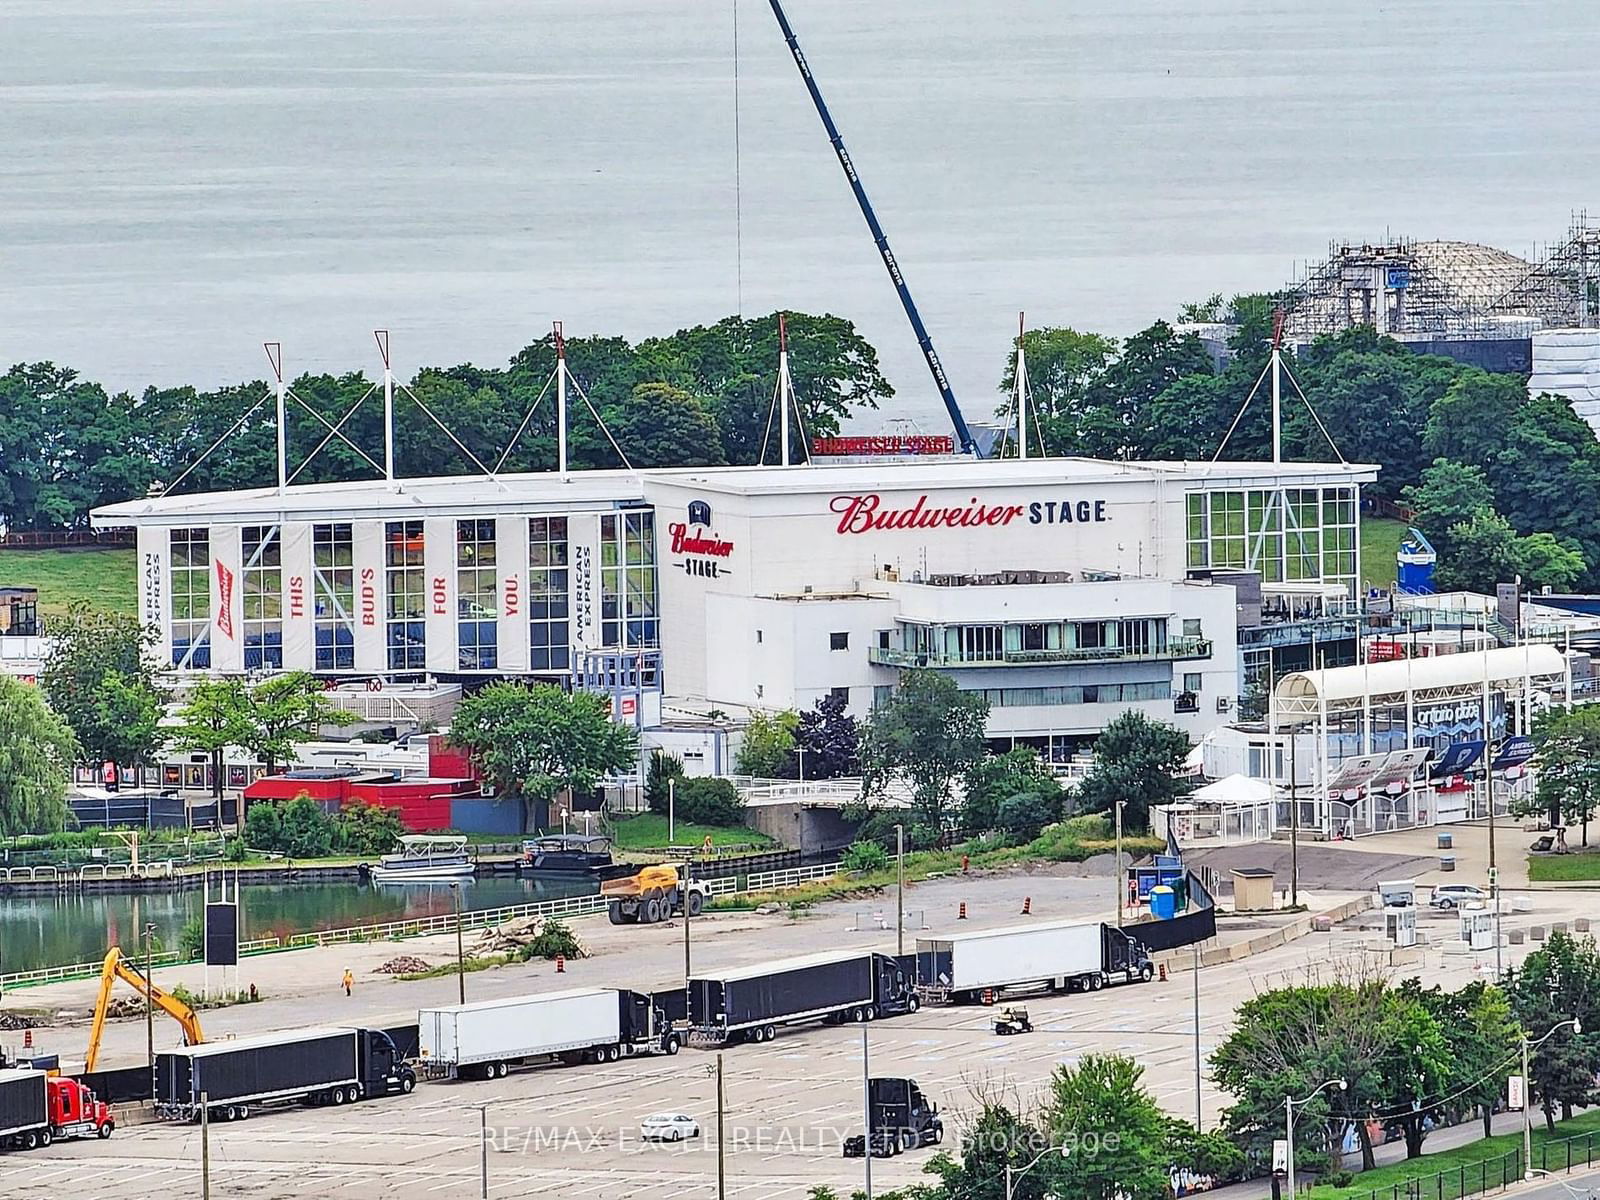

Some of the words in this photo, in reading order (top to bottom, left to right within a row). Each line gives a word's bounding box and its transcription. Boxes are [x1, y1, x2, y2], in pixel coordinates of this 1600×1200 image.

[829, 495, 1024, 534] Budweiser
[1029, 500, 1106, 524] STAGE
[669, 523, 734, 557] Budweiser
[583, 546, 592, 626] EXPRESS
[685, 558, 718, 578] STAGE
[217, 567, 231, 634] Budweiser
[290, 576, 304, 619] THIS
[361, 568, 375, 626] BUD'S
[433, 578, 447, 614] FOR
[505, 573, 519, 617] YOU.
[576, 546, 584, 642] AMERICAN
[1418, 705, 1454, 724] ontario
